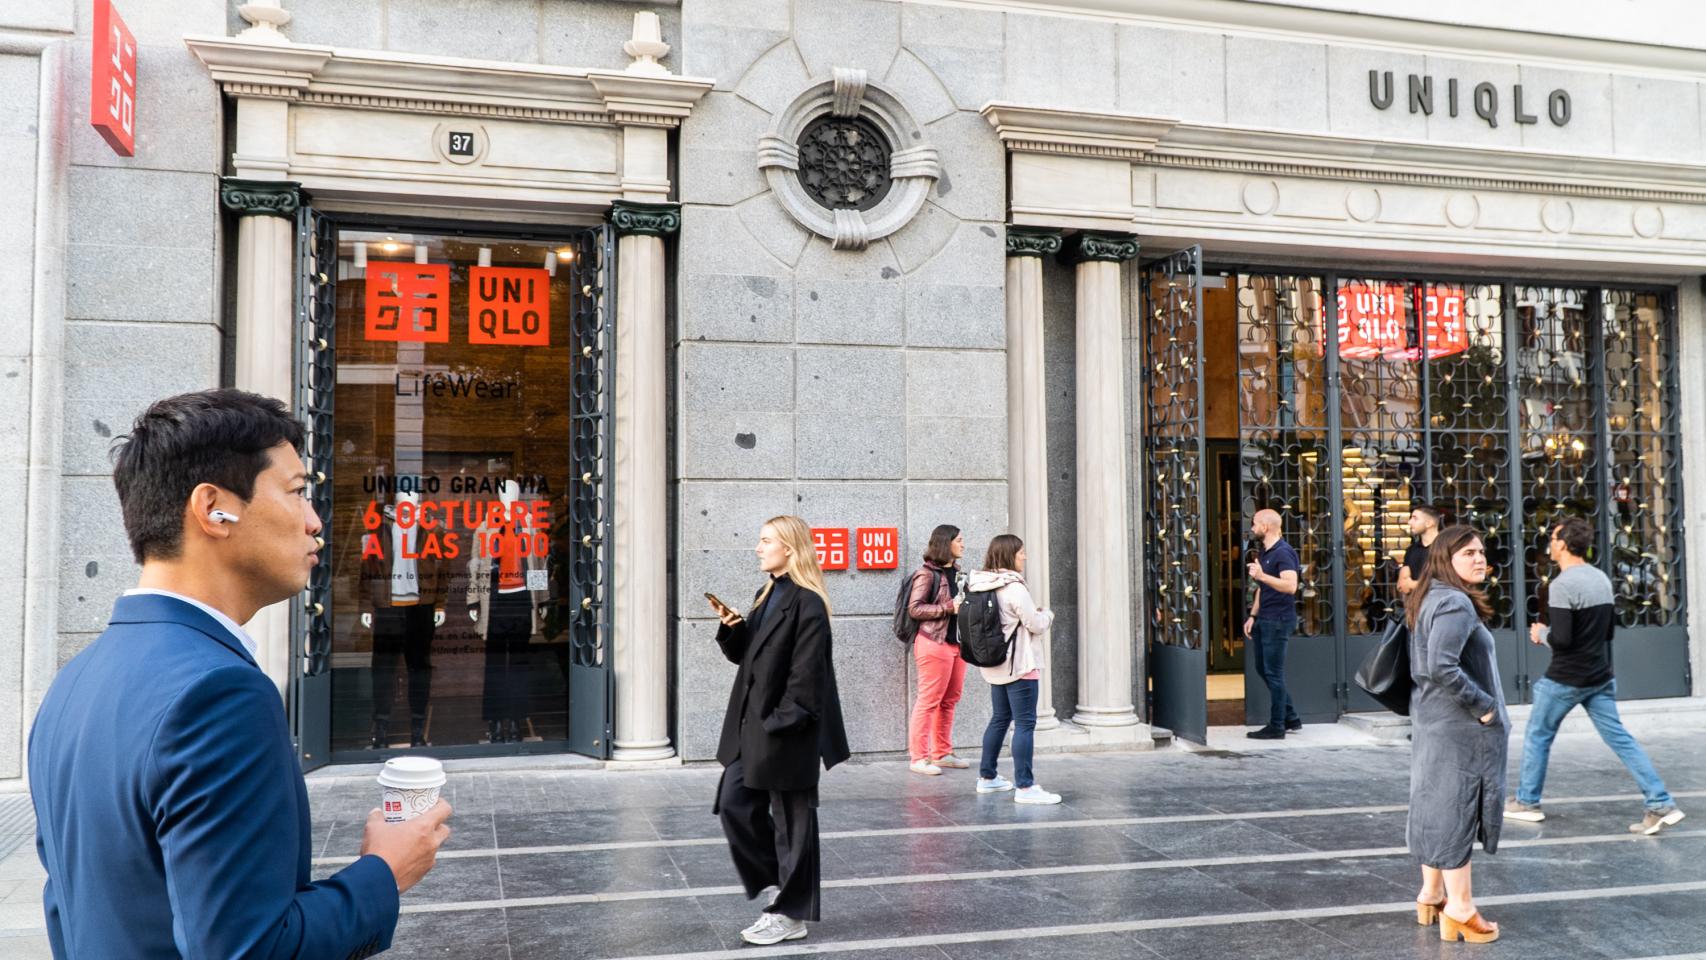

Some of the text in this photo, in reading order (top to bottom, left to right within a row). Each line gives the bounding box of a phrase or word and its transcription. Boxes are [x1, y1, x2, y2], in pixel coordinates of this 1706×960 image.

[1369, 69, 1572, 128] UNIQLO
[452, 134, 471, 151] 37
[478, 276, 535, 304] UNI
[1355, 293, 1395, 316] UNI
[478, 308, 540, 339] QLO
[1357, 317, 1400, 343] QLO
[395, 373, 517, 399] LifeWear
[363, 476, 441, 496] UNIQLO
[450, 476, 506, 494] GRAN
[363, 498, 551, 530] 6 OCTUBRE
[361, 532, 550, 560] A LAS 1000
[862, 532, 891, 547] UNI
[862, 549, 894, 566] QLO
